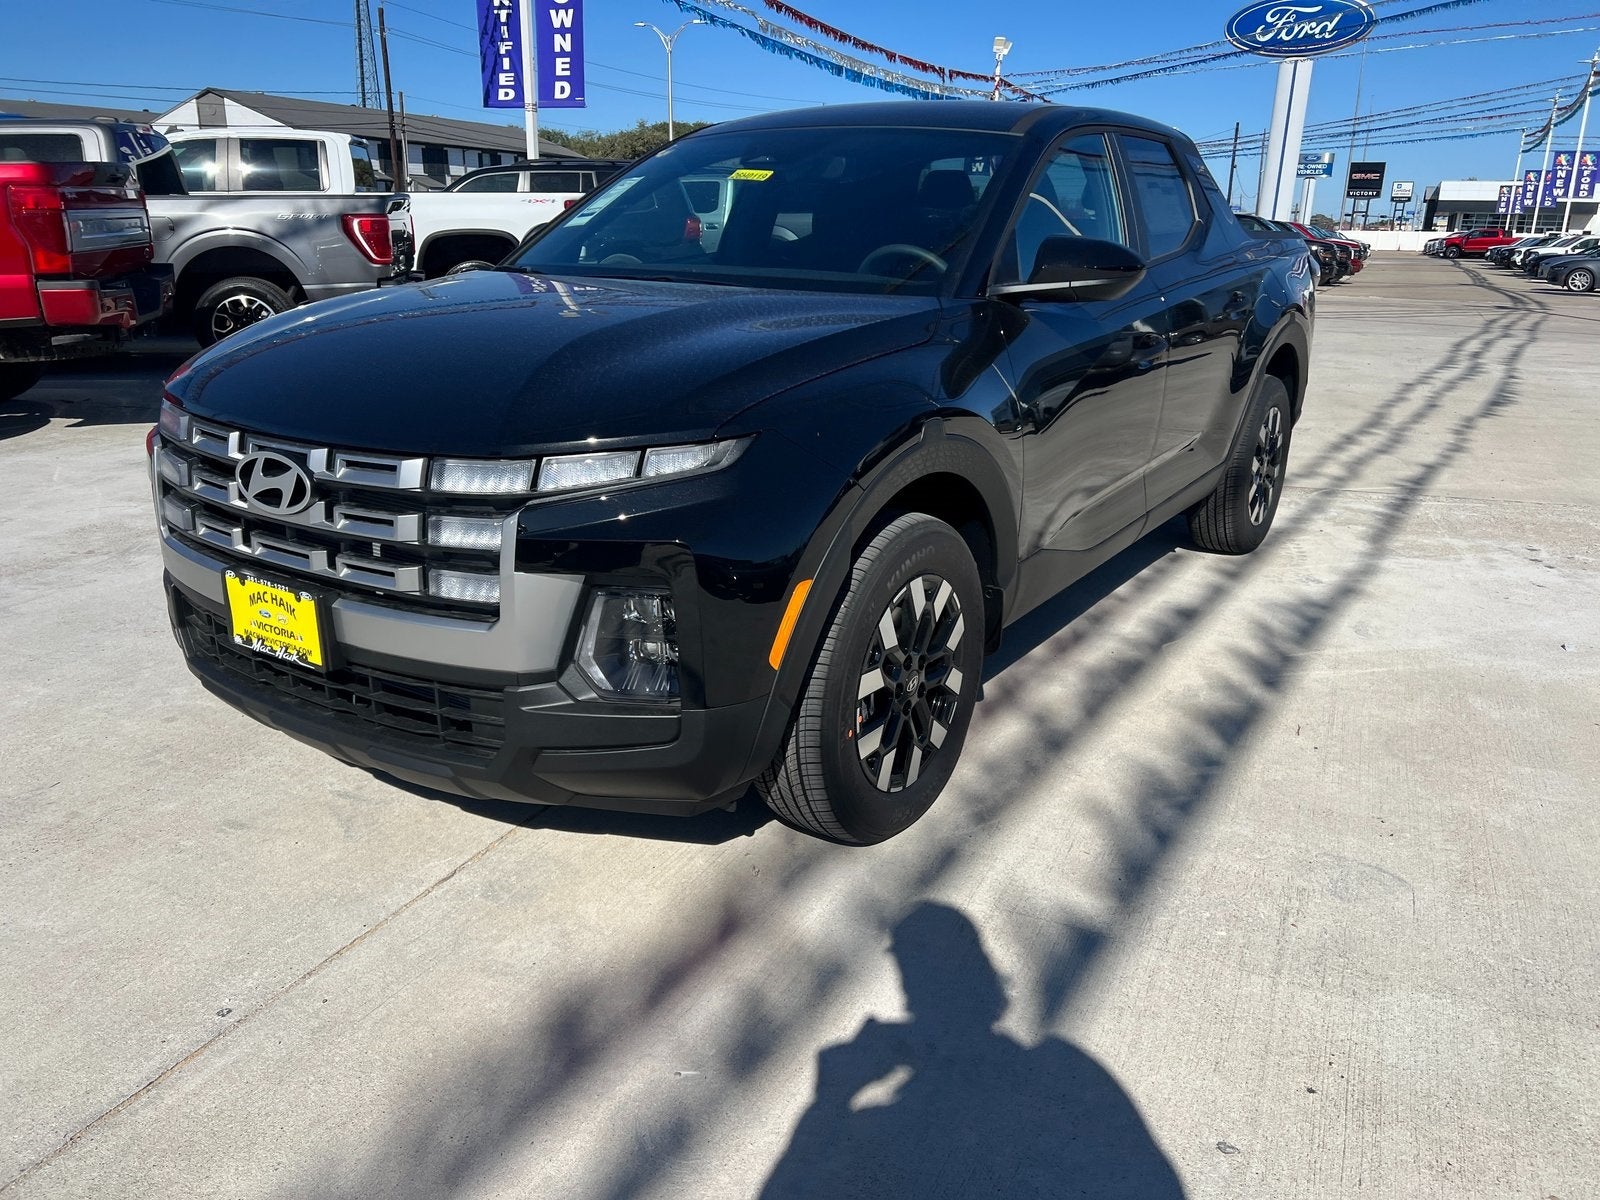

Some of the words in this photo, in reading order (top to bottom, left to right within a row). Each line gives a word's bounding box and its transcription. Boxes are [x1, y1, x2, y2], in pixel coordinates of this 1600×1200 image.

[1255, 5, 1344, 42] Ford
[549, 0, 574, 100] WNED
[1523, 184, 1535, 206] NEW
[1553, 170, 1567, 197] NEW
[1579, 170, 1592, 198] FORD
[1498, 196, 1508, 214] NEW
[249, 591, 269, 607] MAC
[270, 592, 297, 620] HAIK
[255, 619, 297, 641] VICTORIA
[251, 638, 276, 656] Mac
